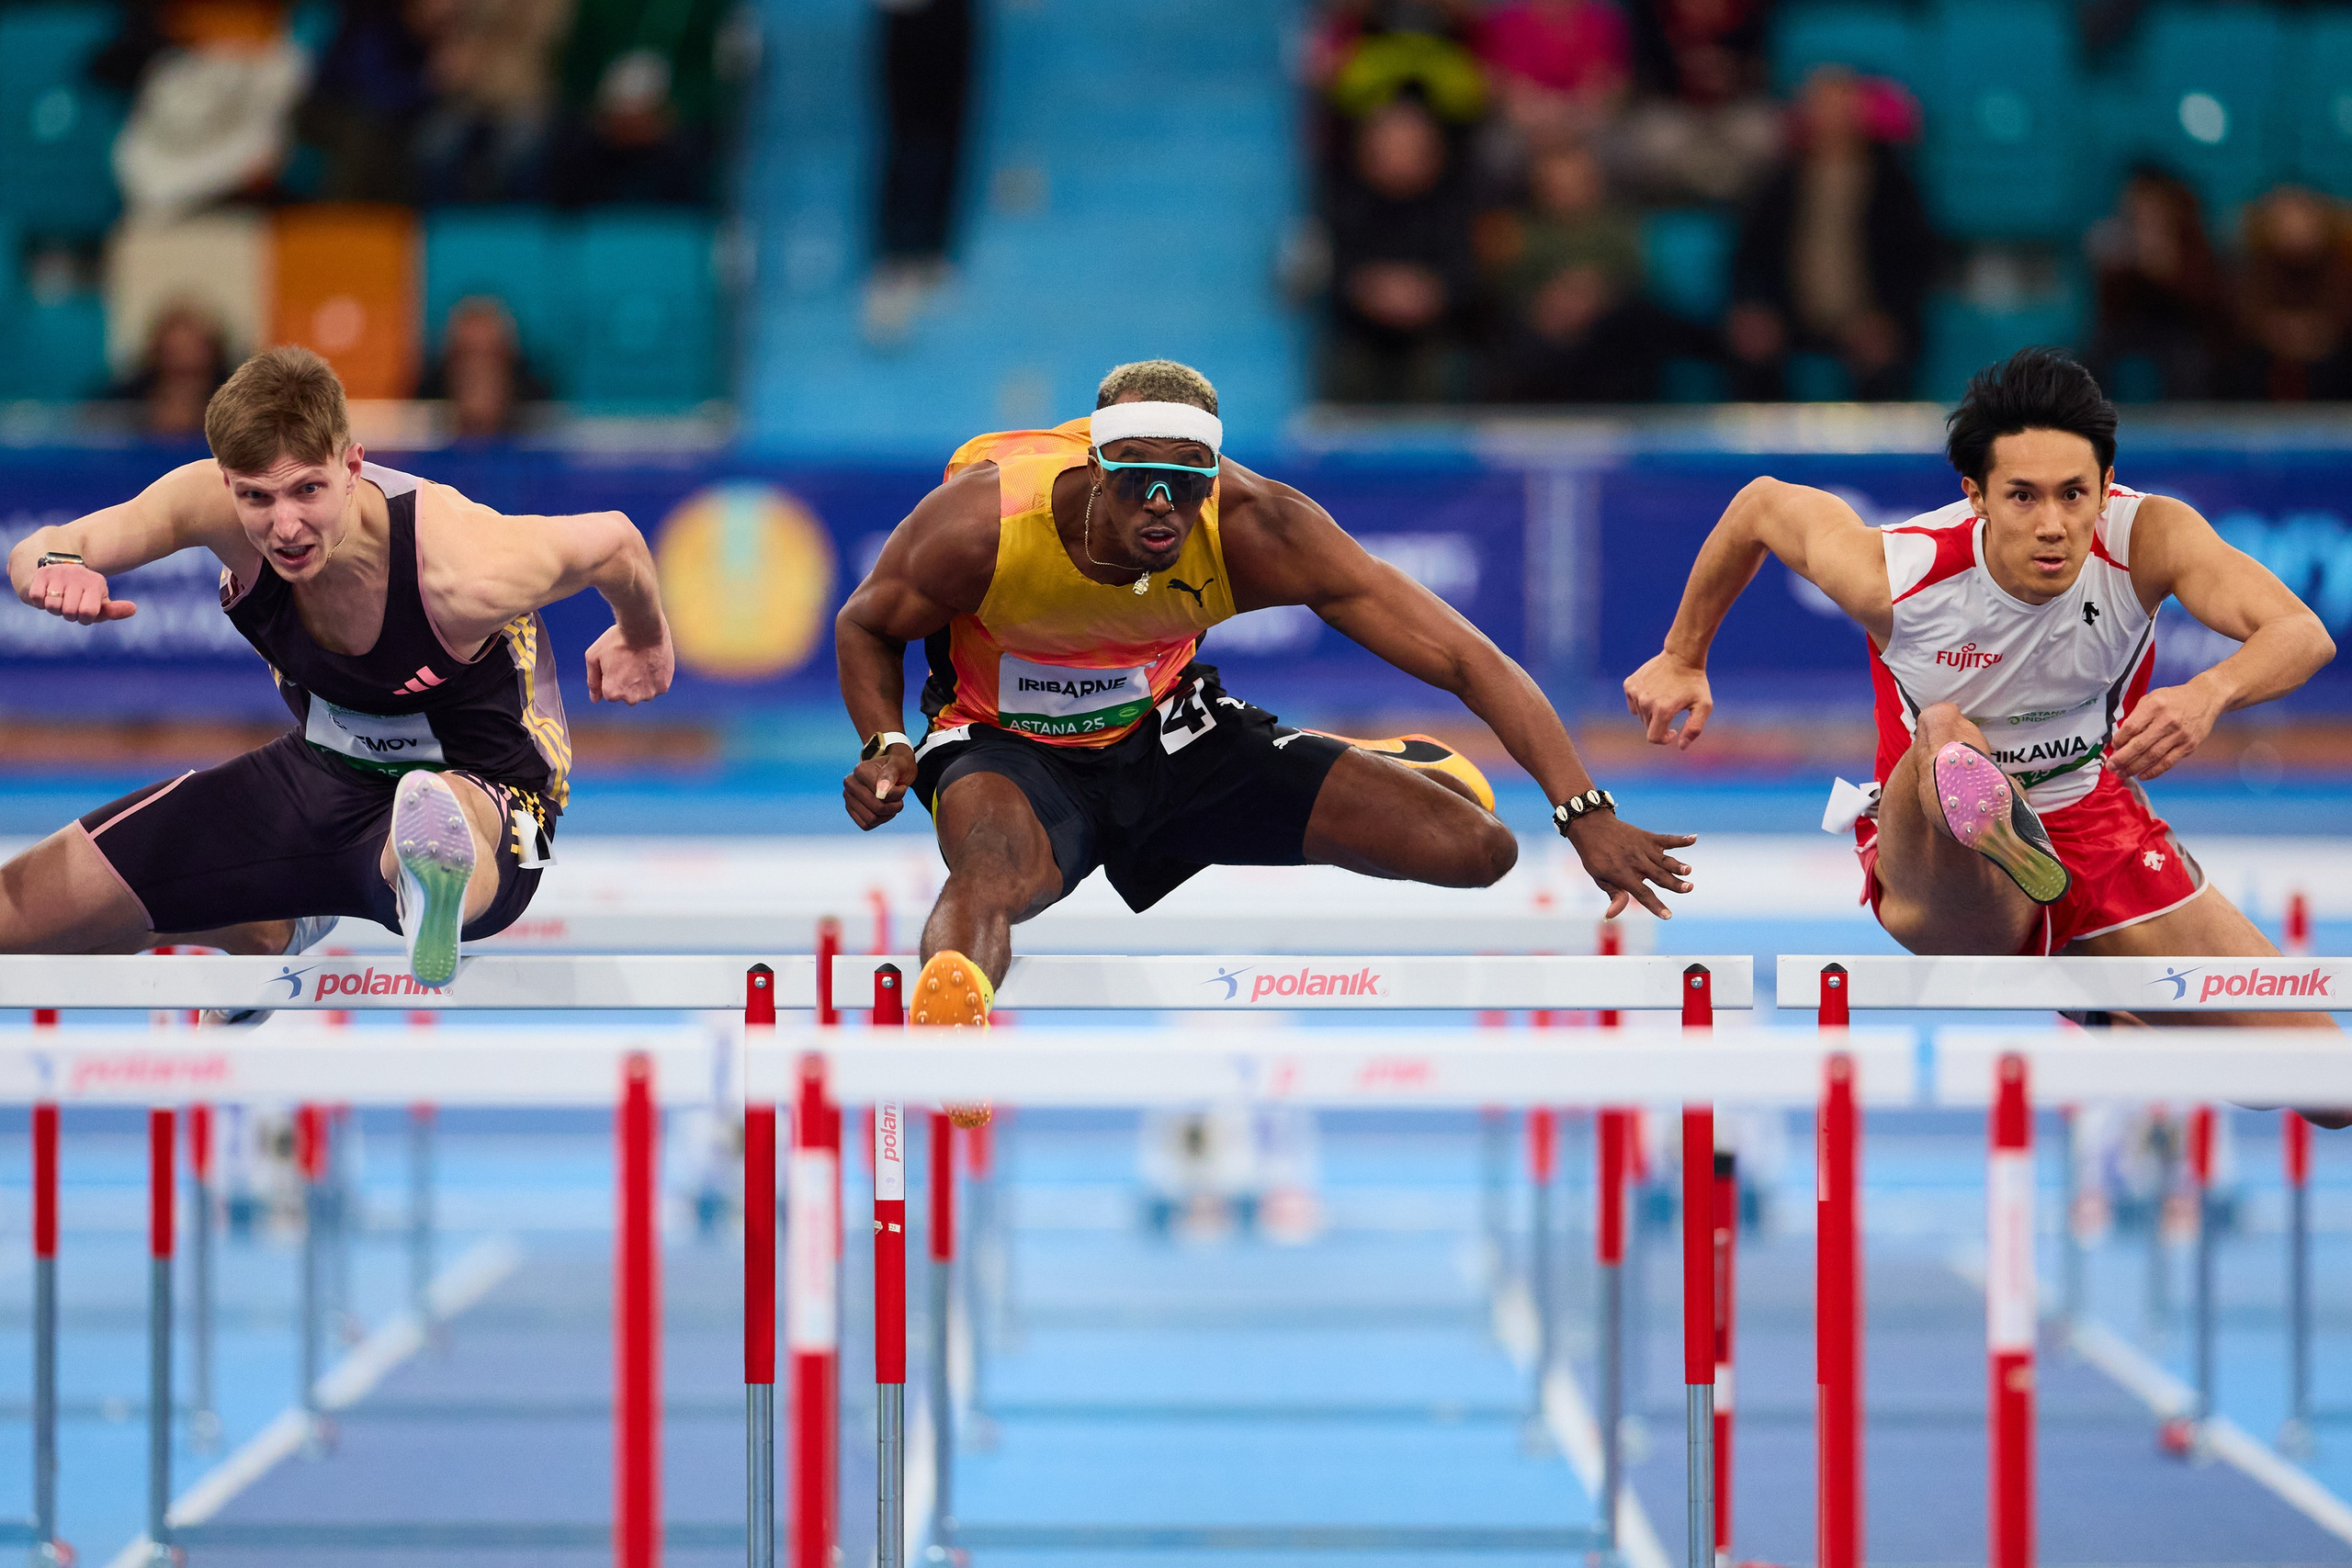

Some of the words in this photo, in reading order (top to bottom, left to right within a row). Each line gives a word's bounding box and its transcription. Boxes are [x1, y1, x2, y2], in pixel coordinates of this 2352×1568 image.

[1936, 643, 2004, 672] FUJITSU
[1019, 677, 1127, 698] IRIBARNE
[1010, 719, 1077, 735] ASTANA
[1082, 717, 1105, 733] 25
[1162, 685, 1206, 736] 4
[1990, 736, 2089, 763] HIKAWA
[1250, 966, 1382, 1003] polanik
[2199, 967, 2332, 1003] polanik
[880, 1100, 900, 1163] polan
